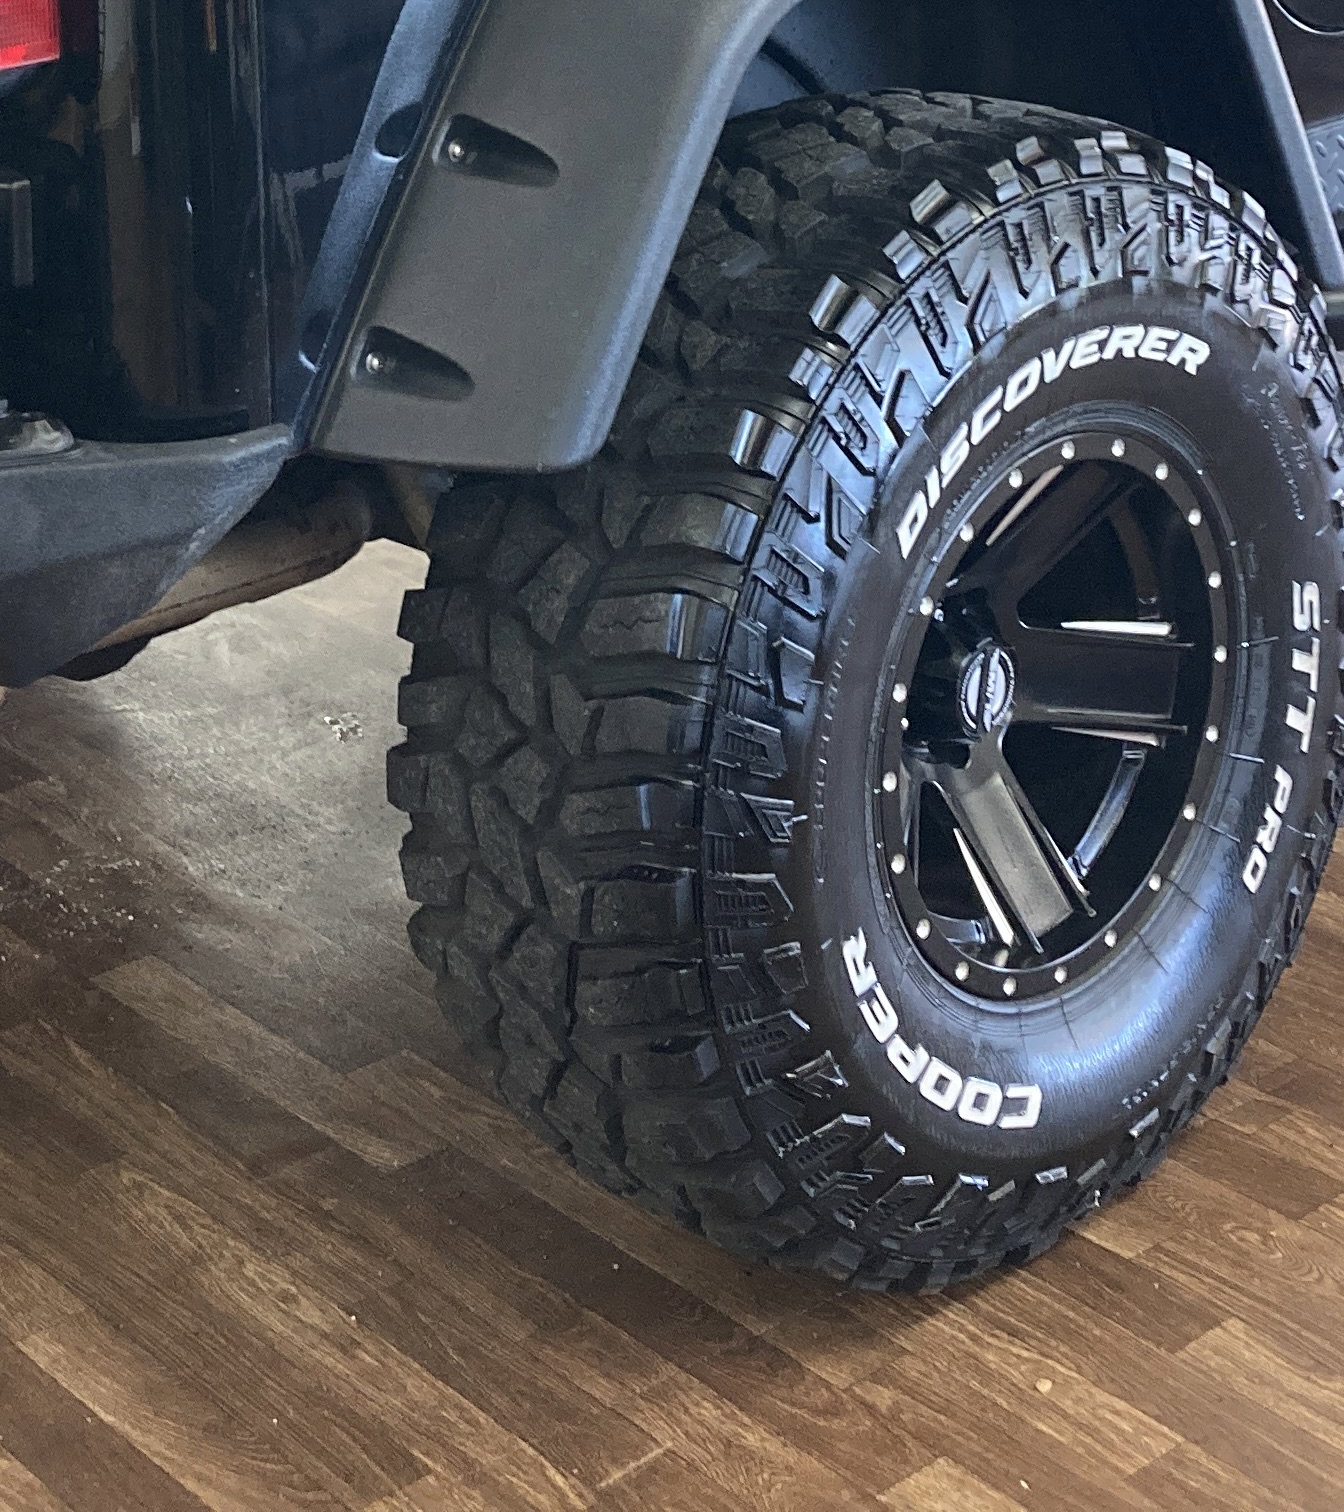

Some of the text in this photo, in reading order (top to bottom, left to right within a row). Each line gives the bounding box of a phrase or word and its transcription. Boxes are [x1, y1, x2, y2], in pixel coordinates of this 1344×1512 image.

[896, 321, 1211, 561] DISCOVERER
[1244, 578, 1323, 894] STT PRO
[842, 926, 1043, 1131] COOPER
